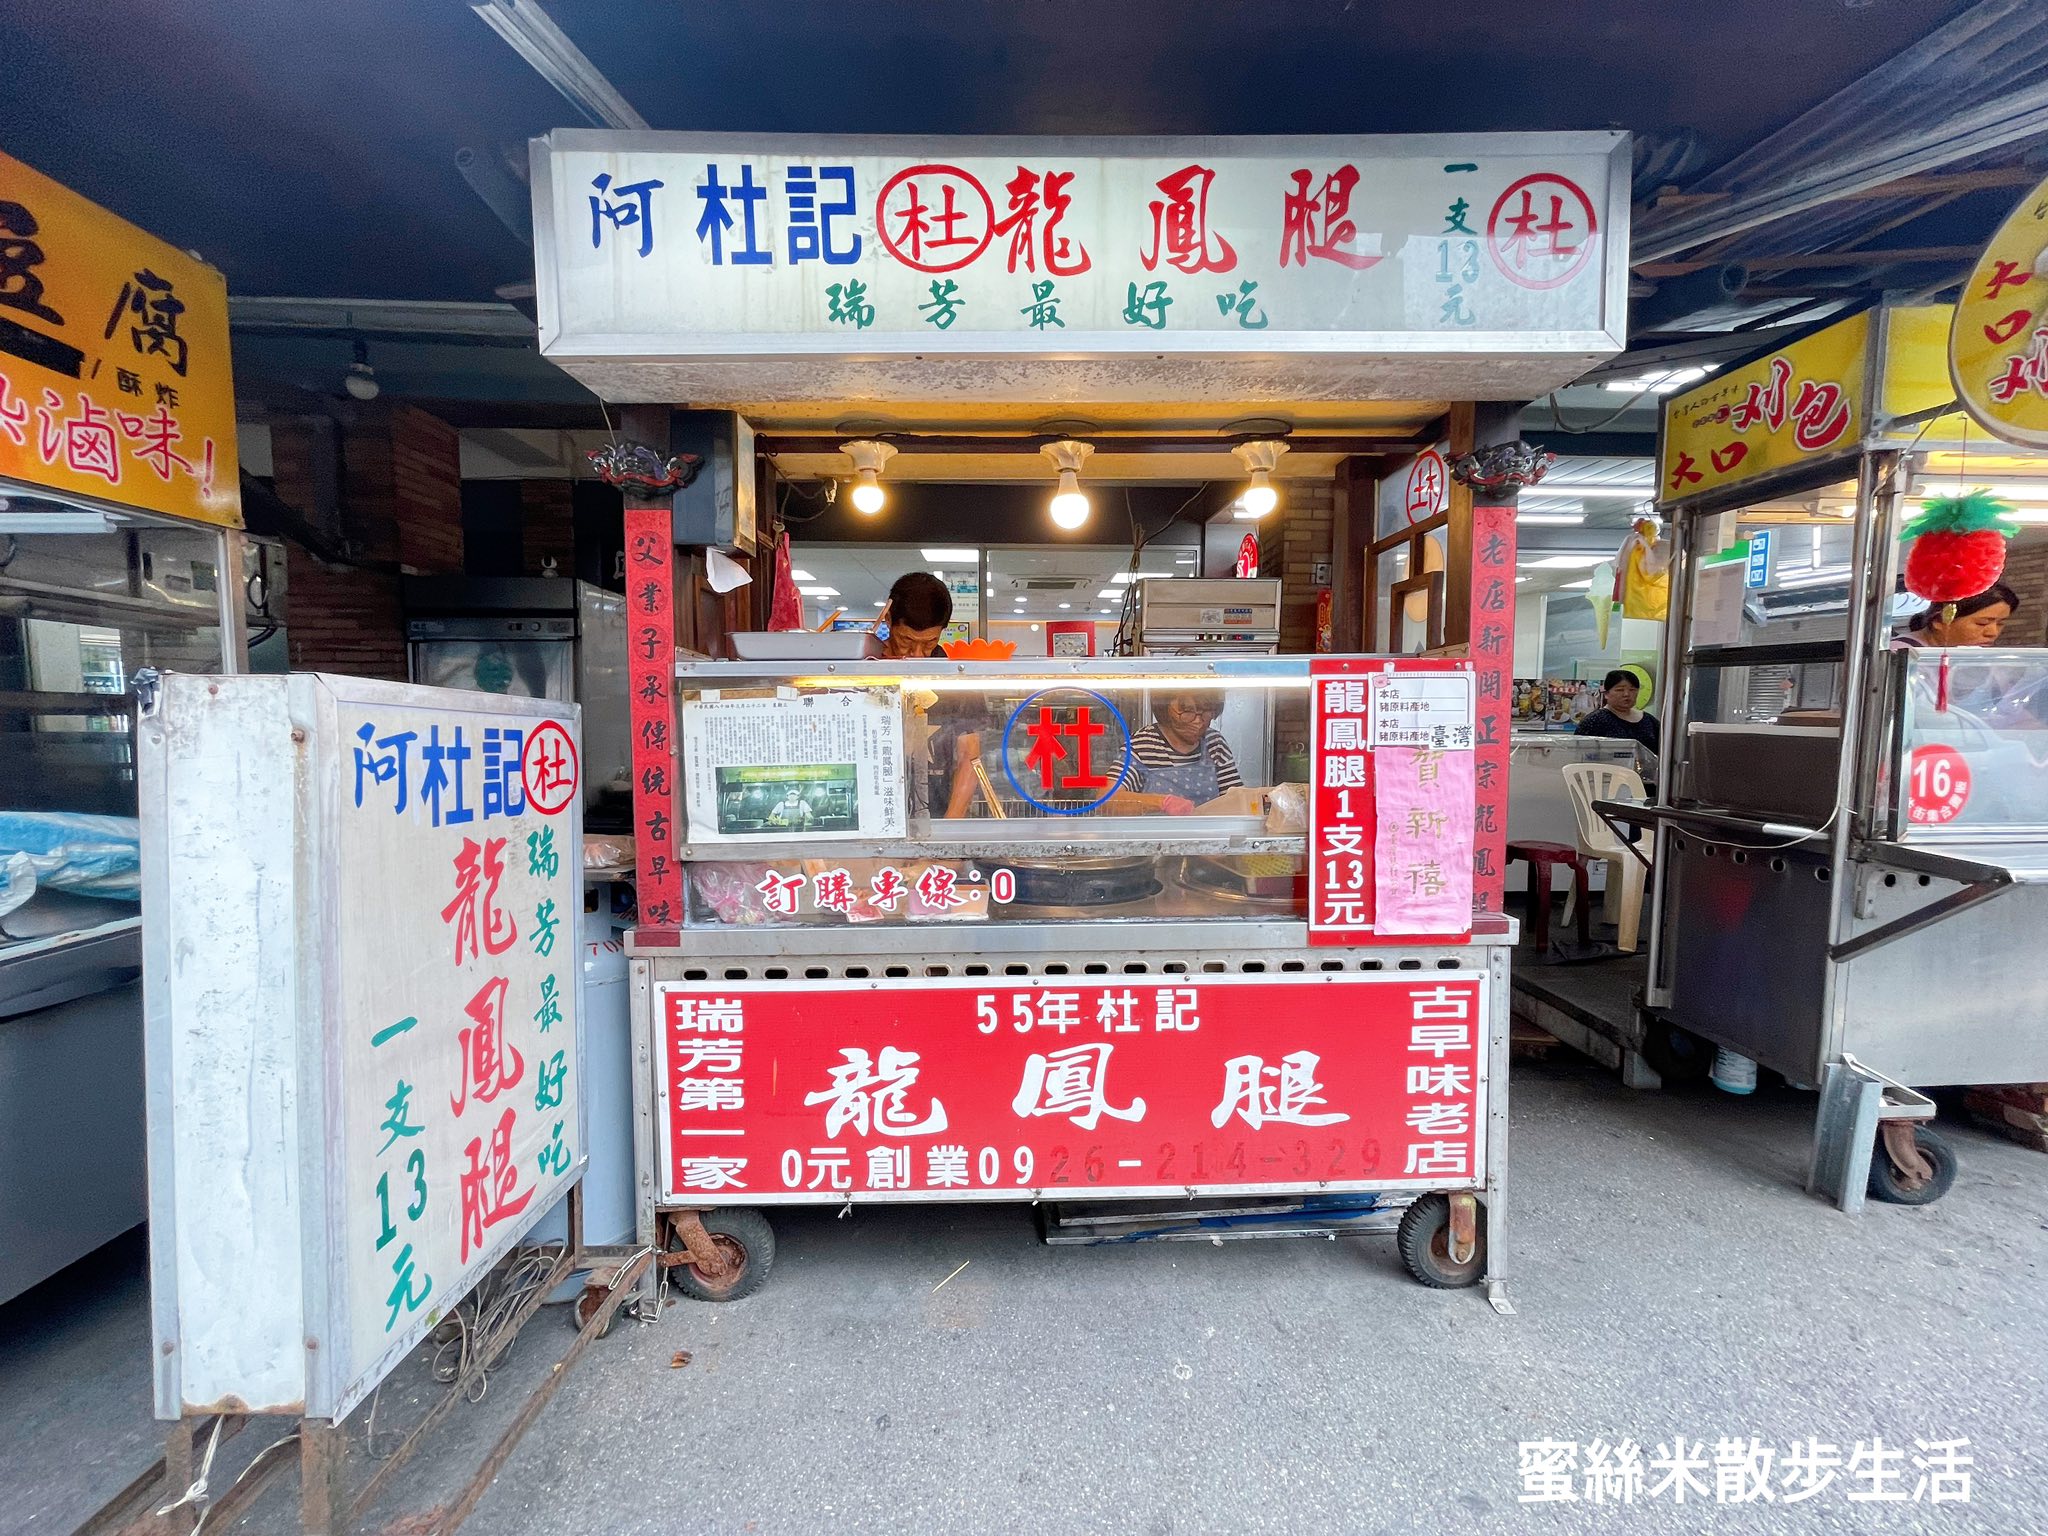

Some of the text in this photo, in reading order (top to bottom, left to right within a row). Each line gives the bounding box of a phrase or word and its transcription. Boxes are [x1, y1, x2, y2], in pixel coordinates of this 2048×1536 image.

[588, 164, 861, 266] 阿杜記
[993, 163, 1384, 277] 龍鳳腿
[1436, 162, 1480, 326] 一支13元
[826, 278, 1268, 330] 瑞芳最好吃
[117, 367, 180, 410] 酥炸
[1670, 441, 1748, 490] 大口
[1380, 690, 1399, 699] 本店
[1380, 719, 1399, 728] 本店
[1431, 725, 1472, 748] 臺灣
[353, 722, 526, 828] 阿杜記
[1323, 681, 1366, 924] 龍鳳腿1支13元
[1914, 759, 1951, 798] 16
[442, 836, 536, 1266] 龍鳳腿
[527, 824, 572, 1178] 瑞芳最好吃
[675, 998, 748, 1190] 瑞芳第一家
[804, 1043, 1351, 1140] 龍鳳腿
[1403, 986, 1472, 1175] 古早味老店
[370, 1015, 431, 1332] 一支13元
